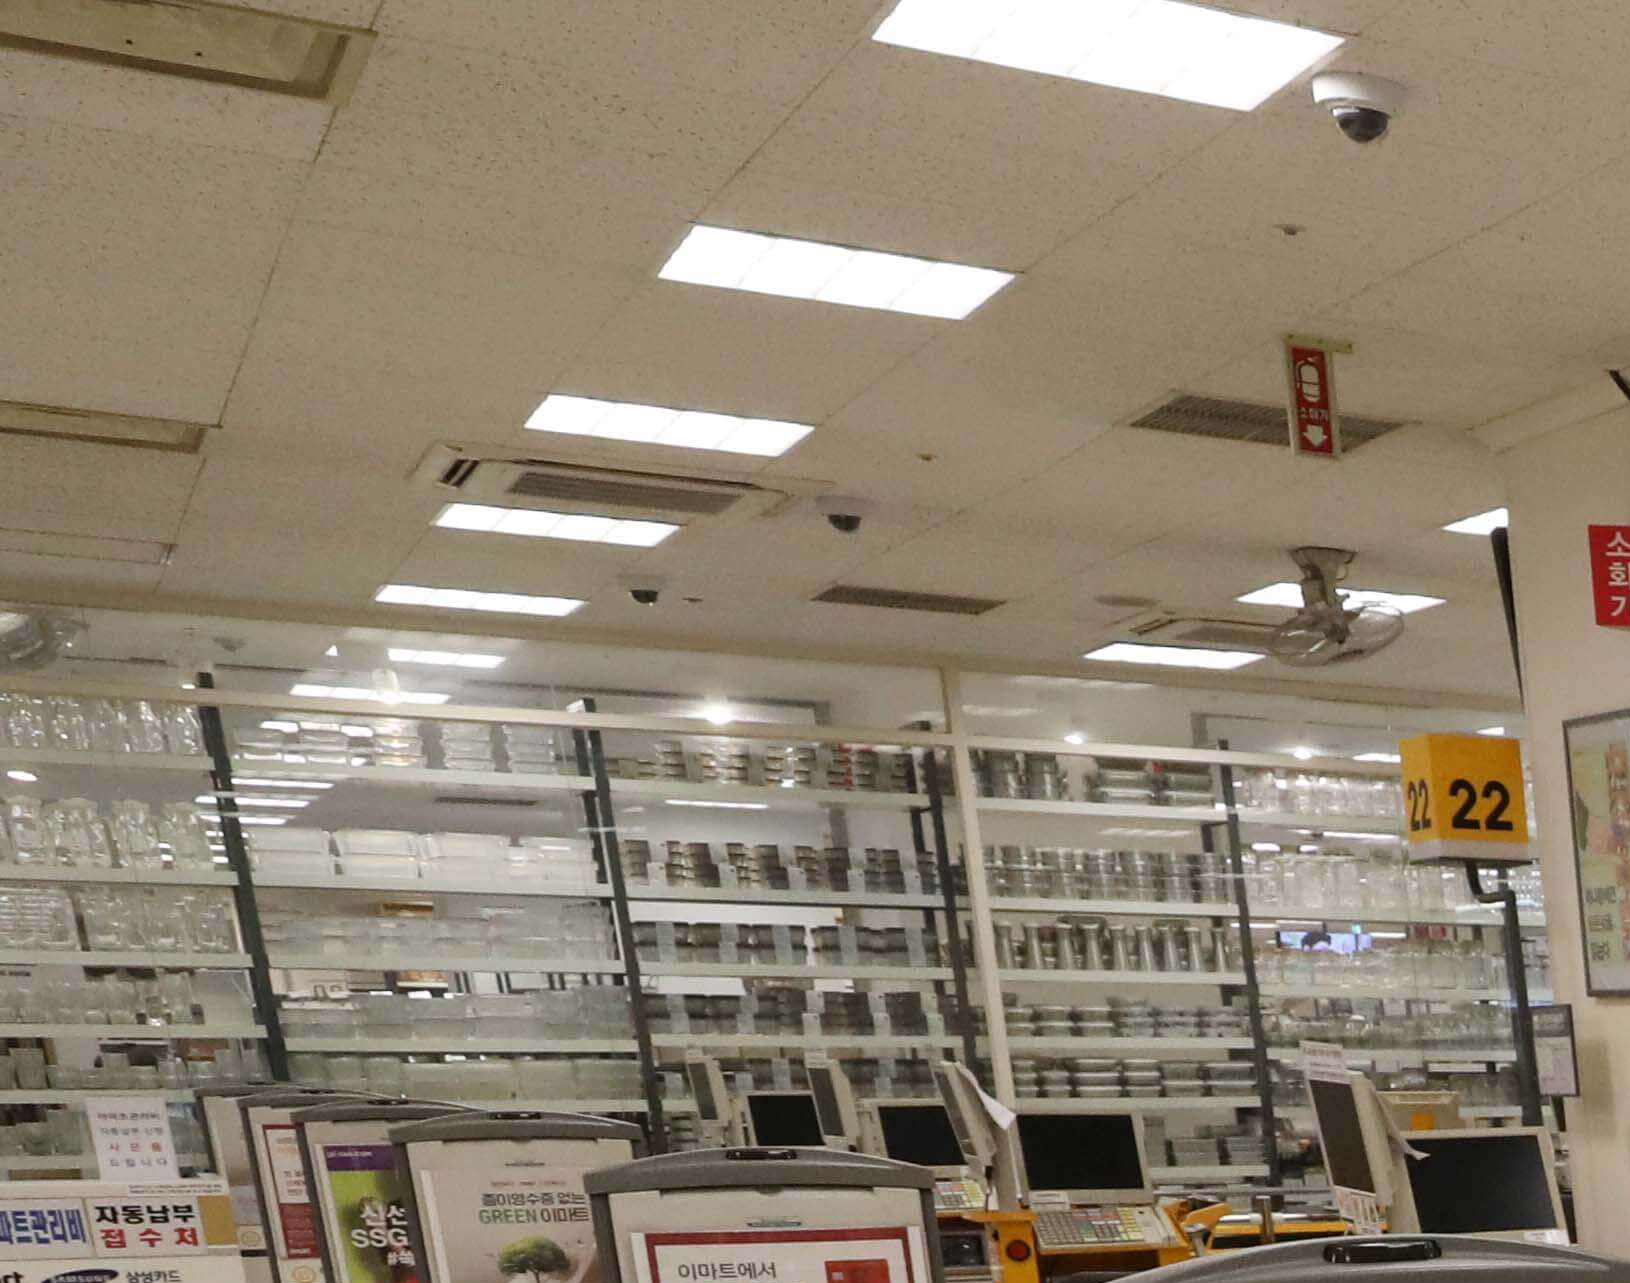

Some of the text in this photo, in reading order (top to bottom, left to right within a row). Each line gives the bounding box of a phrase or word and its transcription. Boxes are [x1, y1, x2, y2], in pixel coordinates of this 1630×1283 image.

[1408, 779, 1431, 832] 22
[1449, 778, 1513, 832] 22
[557, 1191, 588, 1205] 없는
[94, 1203, 196, 1225] 자동납부
[479, 1206, 590, 1226] GREEN 이마트
[677, 1261, 777, 1282] 이마트에서
